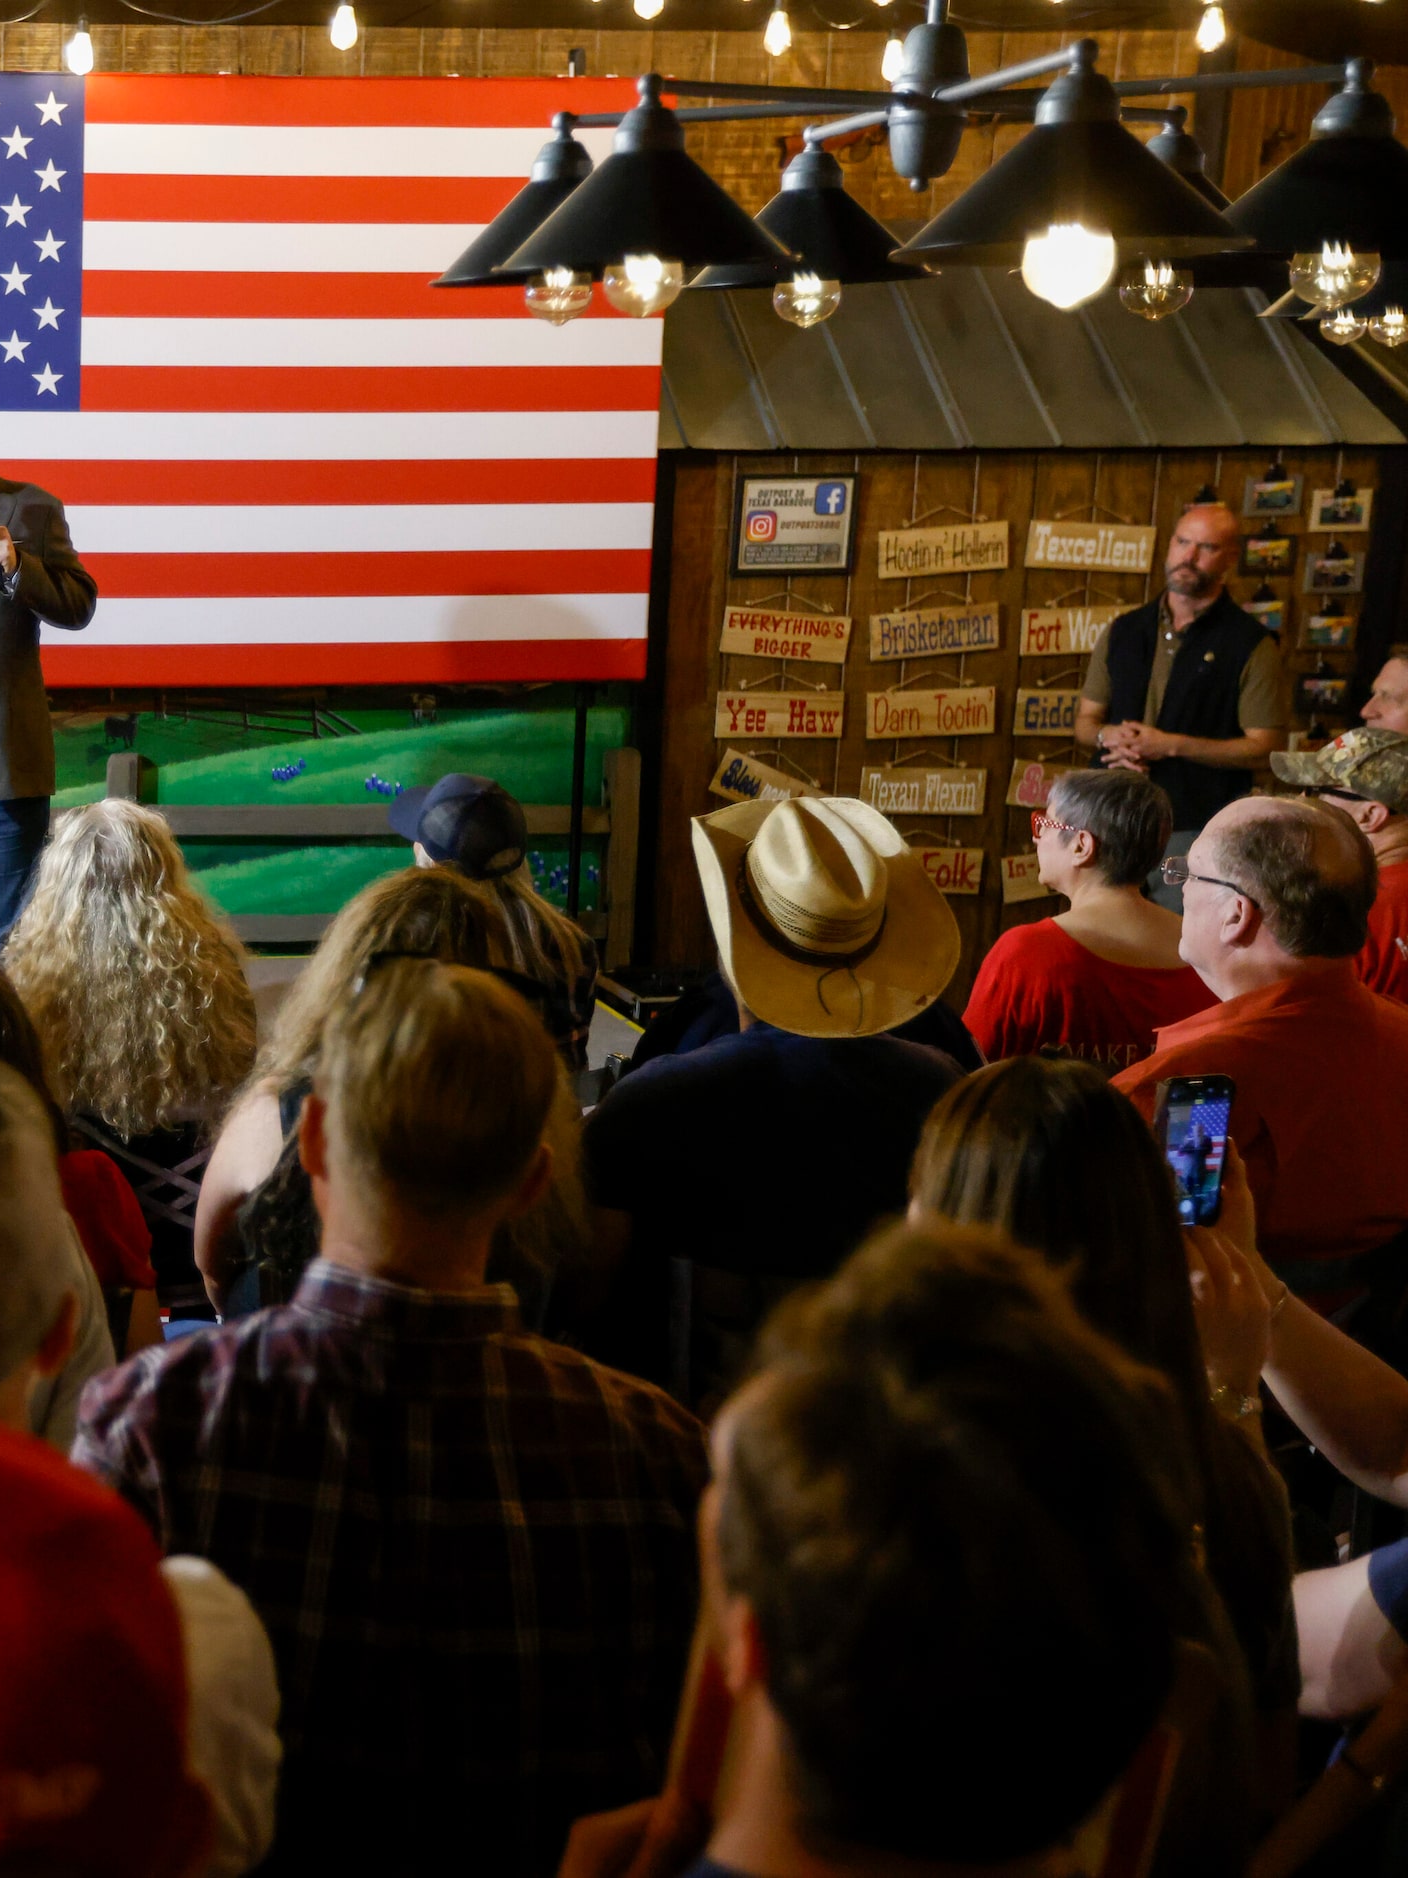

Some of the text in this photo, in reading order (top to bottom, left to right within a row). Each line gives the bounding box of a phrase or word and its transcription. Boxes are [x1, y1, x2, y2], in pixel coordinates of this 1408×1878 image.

[885, 536, 931, 571] Hootin
[952, 529, 1004, 567] Hollerin
[1034, 523, 1147, 567] Texcellent
[754, 638, 812, 658] BIGGER
[879, 610, 995, 656] Brisketarian
[1027, 612, 1062, 652] Fort
[726, 699, 840, 733] Yee Haw
[874, 689, 994, 734] Darn Tootin'
[1024, 696, 1077, 730] Gidd
[869, 773, 920, 811] Texan
[922, 770, 983, 812] Flexin'
[922, 851, 976, 889] Folk
